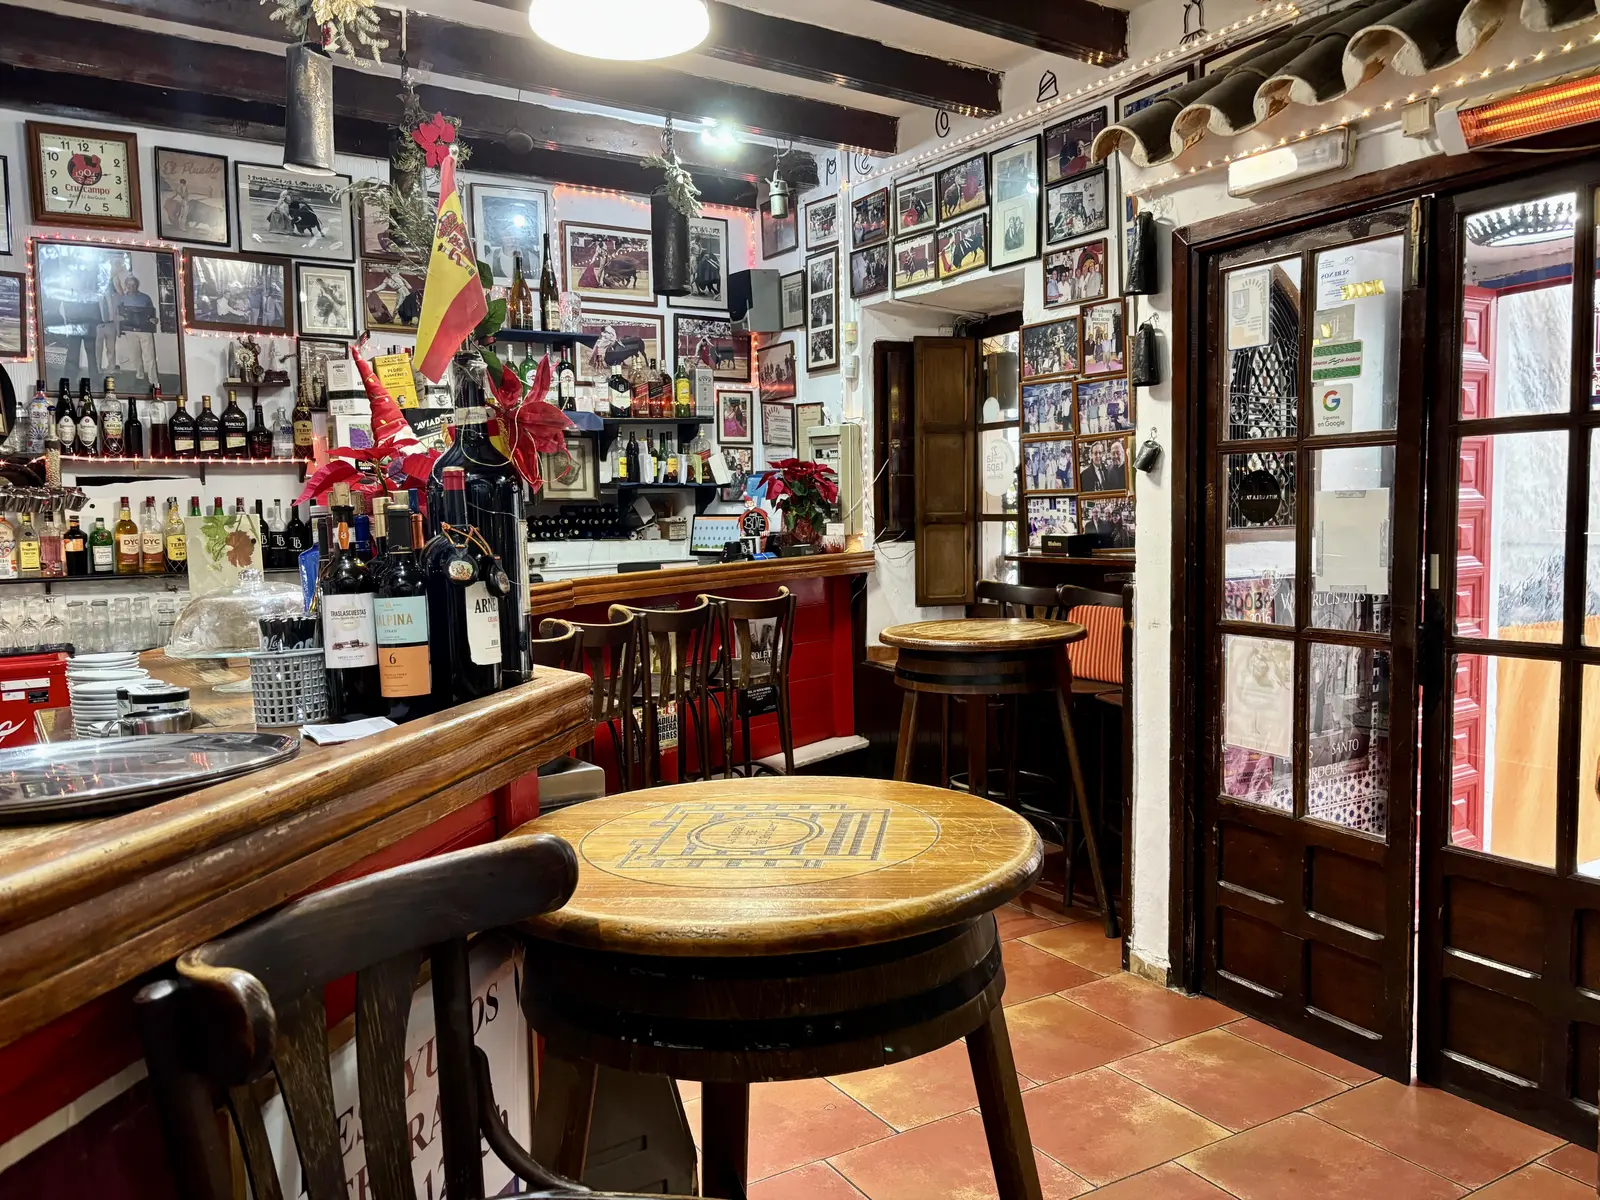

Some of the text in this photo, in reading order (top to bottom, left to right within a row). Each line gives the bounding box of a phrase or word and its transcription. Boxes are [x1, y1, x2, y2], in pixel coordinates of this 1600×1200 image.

[60, 141, 70, 150] 11
[77, 143, 90, 152] 12
[100, 145, 104, 154] 1
[46, 152, 59, 161] 10
[113, 159, 121, 168] 2
[50, 169, 57, 178] 9
[115, 176, 122, 185] 3
[51, 186, 59, 196] 8
[114, 193, 123, 201] 4
[67, 200, 74, 209] 7
[84, 203, 92, 212] 6
[102, 203, 110, 212] 5
[1324, 420, 1346, 428] Google
[1312, 591, 1340, 607] RUCIS
[474, 597, 499, 613] ARNE
[389, 652, 397, 665] 6
[1331, 738, 1360, 755] SANTO
